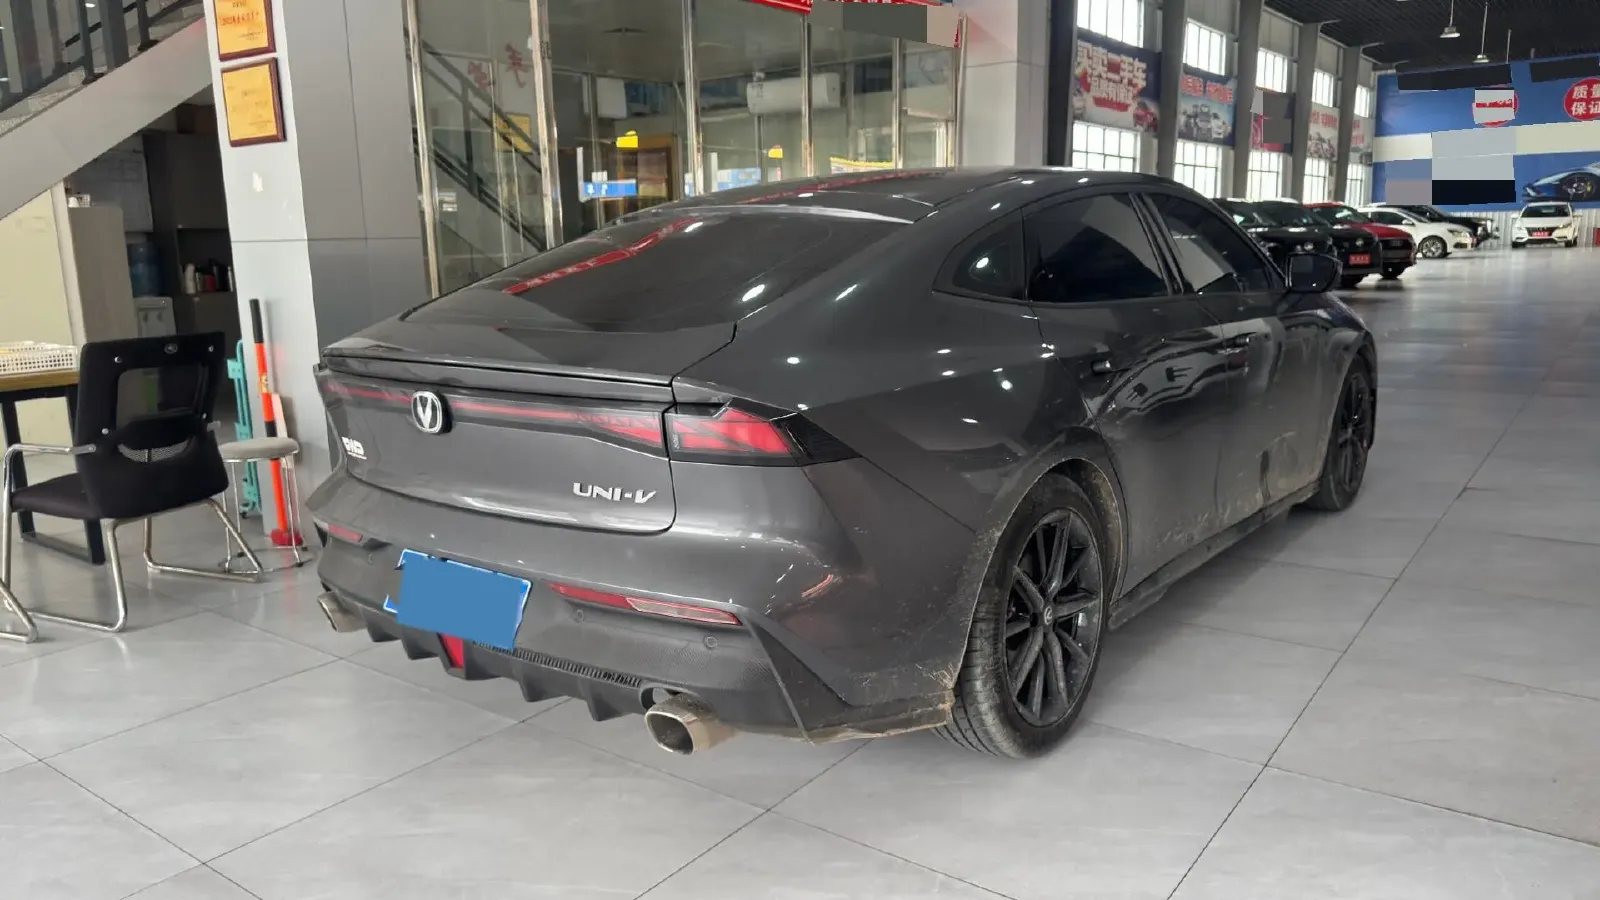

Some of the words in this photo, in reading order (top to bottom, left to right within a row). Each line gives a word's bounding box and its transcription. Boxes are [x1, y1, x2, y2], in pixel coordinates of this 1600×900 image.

[1075, 40, 1147, 88] 买卖二手车
[1572, 83, 1600, 99] 质量
[1571, 101, 1600, 116] 保证
[573, 482, 657, 504] UNI-V
